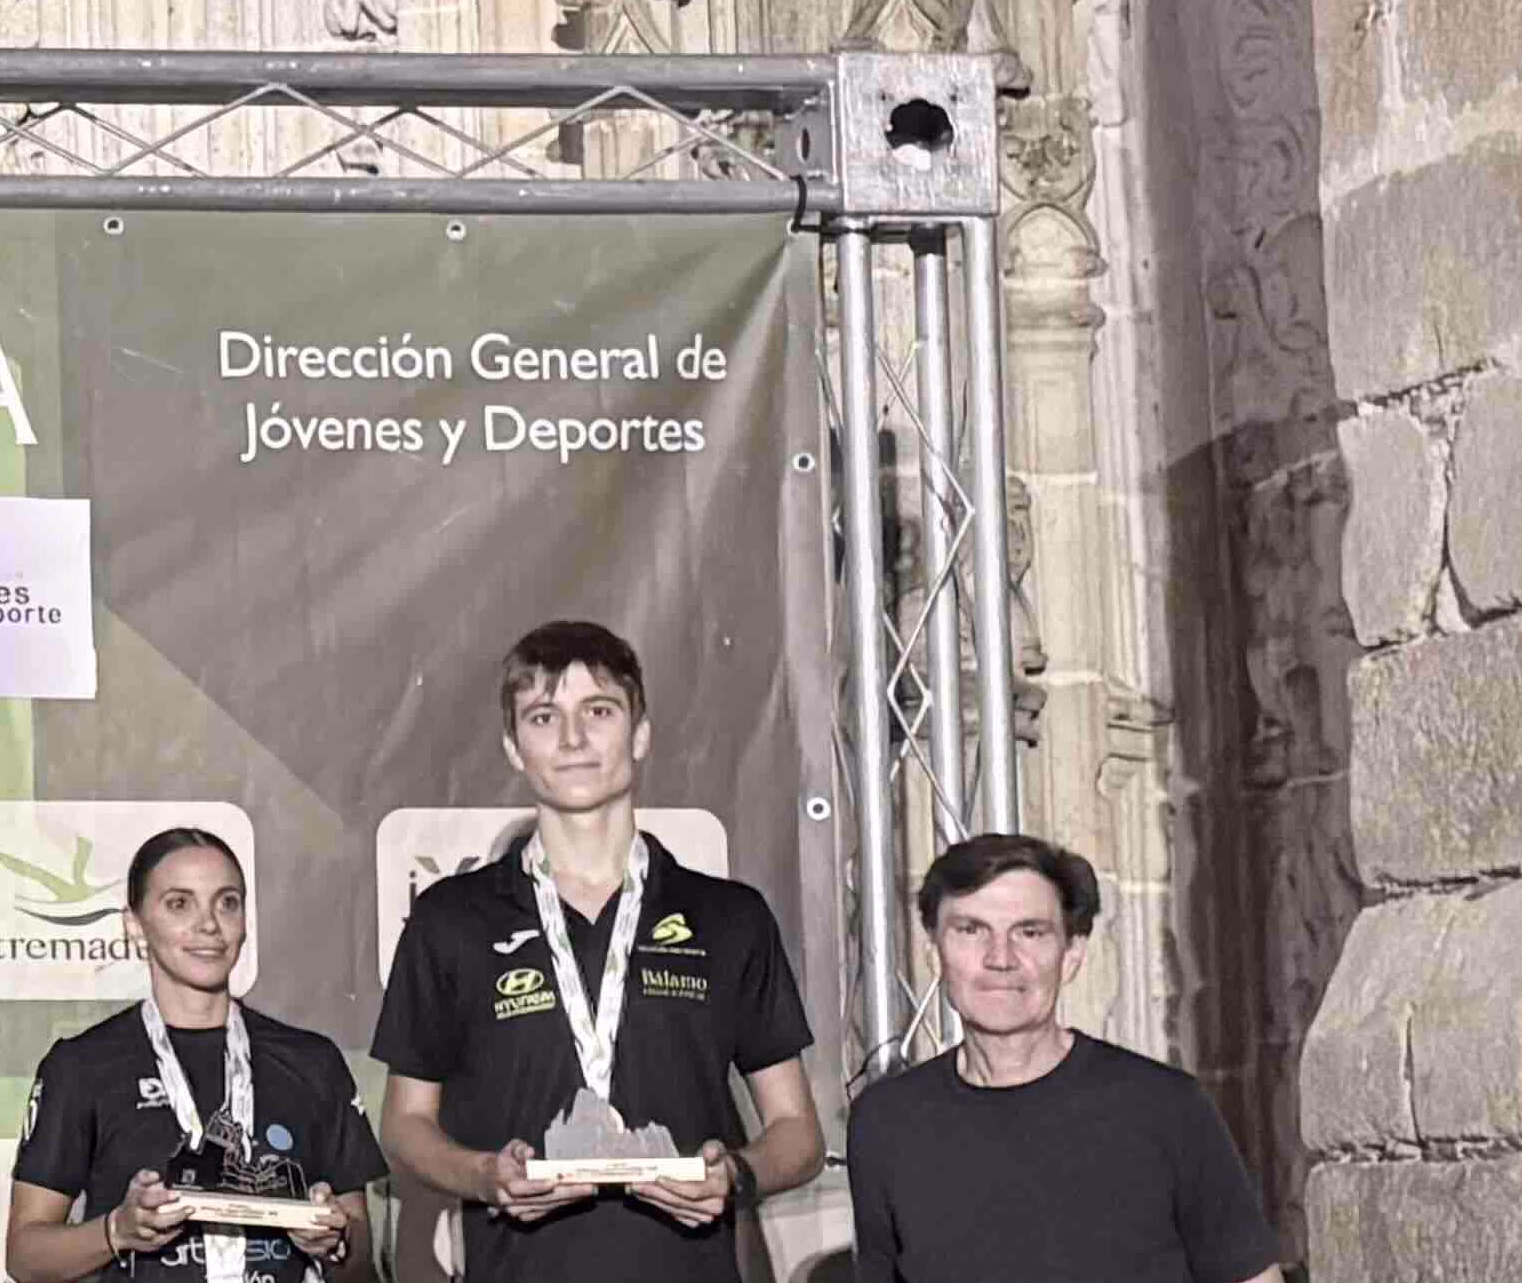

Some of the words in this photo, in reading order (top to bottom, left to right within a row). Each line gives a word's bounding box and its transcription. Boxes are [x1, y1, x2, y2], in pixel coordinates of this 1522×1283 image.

[219, 330, 452, 380] Dirección
[470, 333, 659, 381] General
[676, 334, 727, 381] de
[241, 402, 423, 463] Jóvenes
[441, 419, 467, 464] y
[485, 405, 705, 464] Deportes
